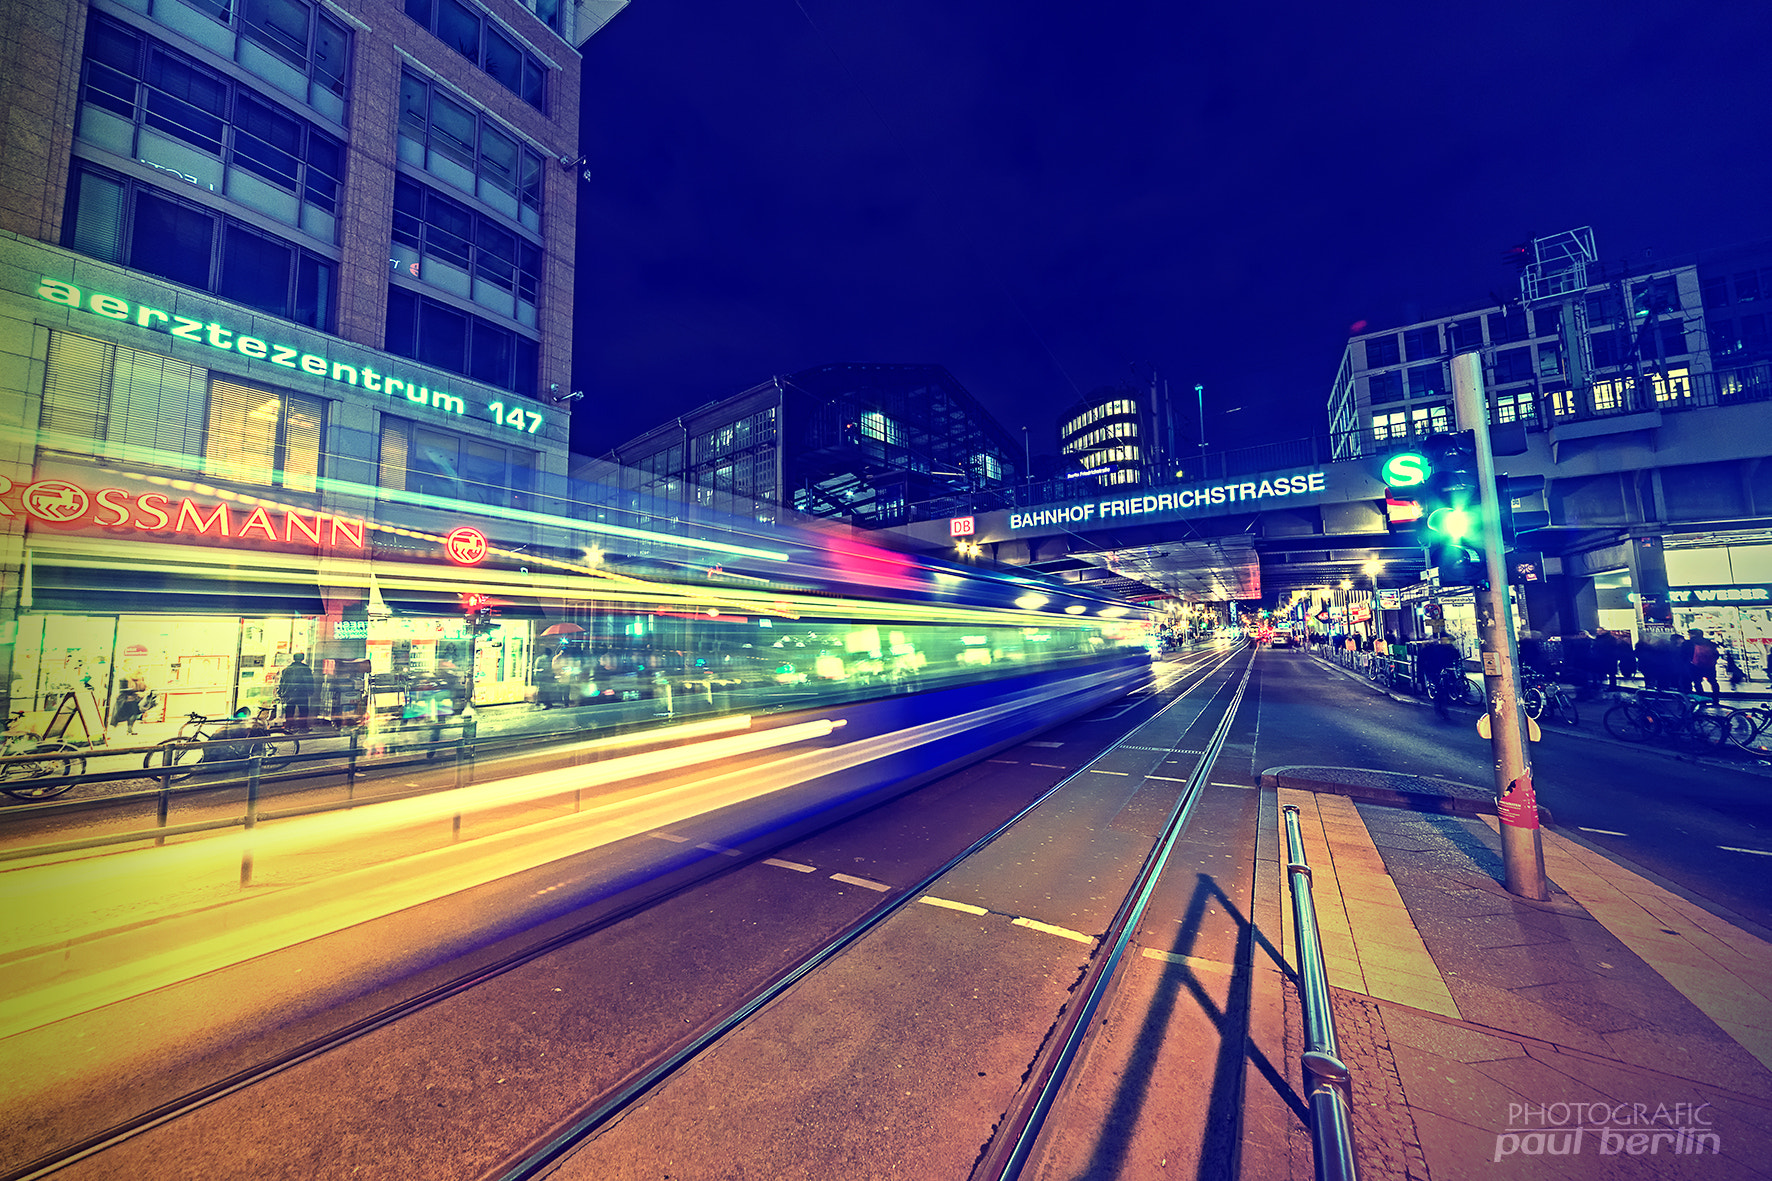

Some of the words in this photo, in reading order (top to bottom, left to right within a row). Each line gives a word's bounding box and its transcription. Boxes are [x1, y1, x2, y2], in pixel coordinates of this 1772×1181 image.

[37, 278, 466, 415] aerztezentrum
[488, 402, 543, 434] 147
[1388, 455, 1424, 487] S
[1010, 503, 1095, 529] BAHNHOF
[1099, 472, 1326, 519] FRIEDRICHSTRASSE
[954, 519, 971, 534] DB
